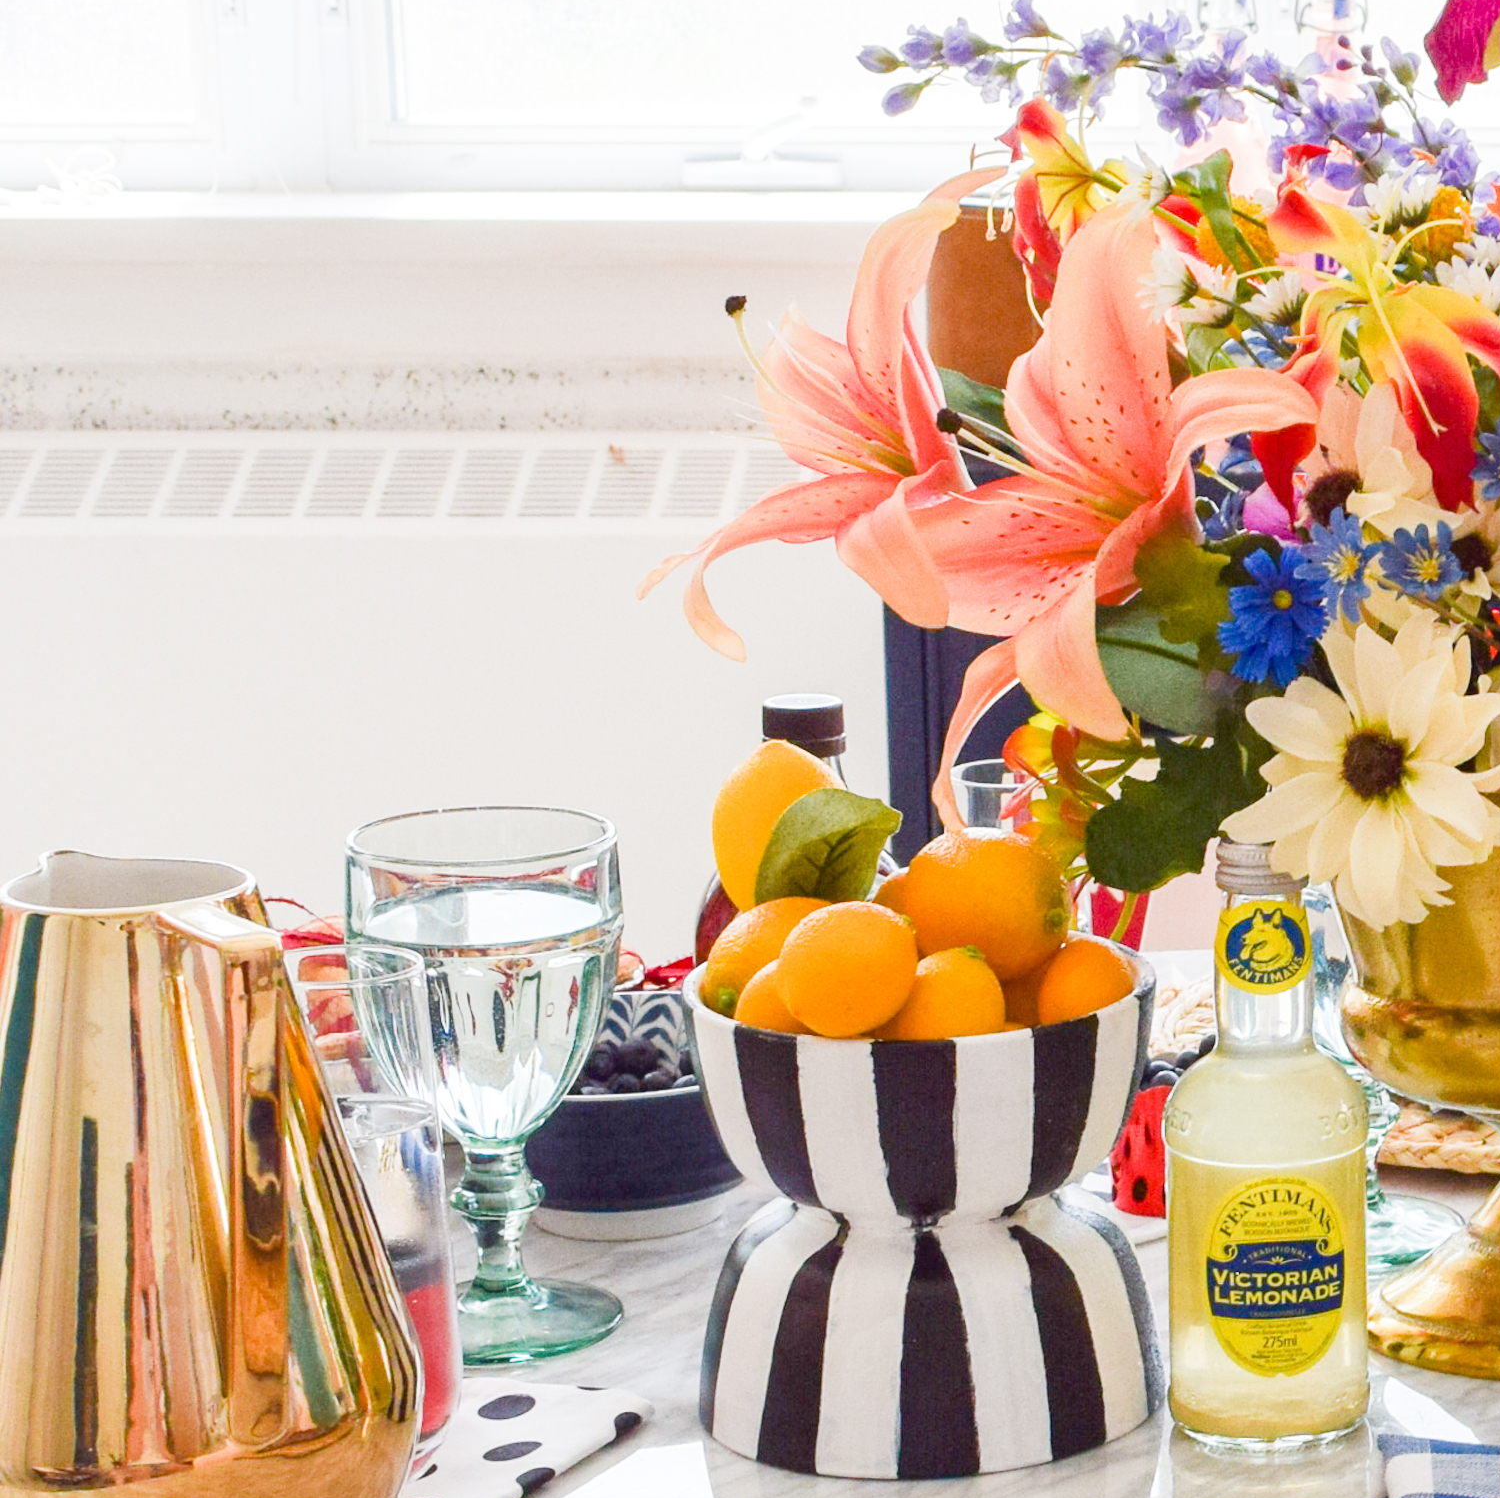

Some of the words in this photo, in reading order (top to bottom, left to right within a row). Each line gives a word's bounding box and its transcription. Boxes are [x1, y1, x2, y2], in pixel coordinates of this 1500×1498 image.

[1228, 956, 1303, 983] FENTIMANS
[1219, 1189, 1332, 1238] FENTIMANS
[1248, 1245, 1307, 1259] TRADITIONAL
[1212, 1263, 1338, 1288] VICTORIAN
[1213, 1280, 1341, 1306] LEMONADE
[1262, 1334, 1298, 1349] 275ml
